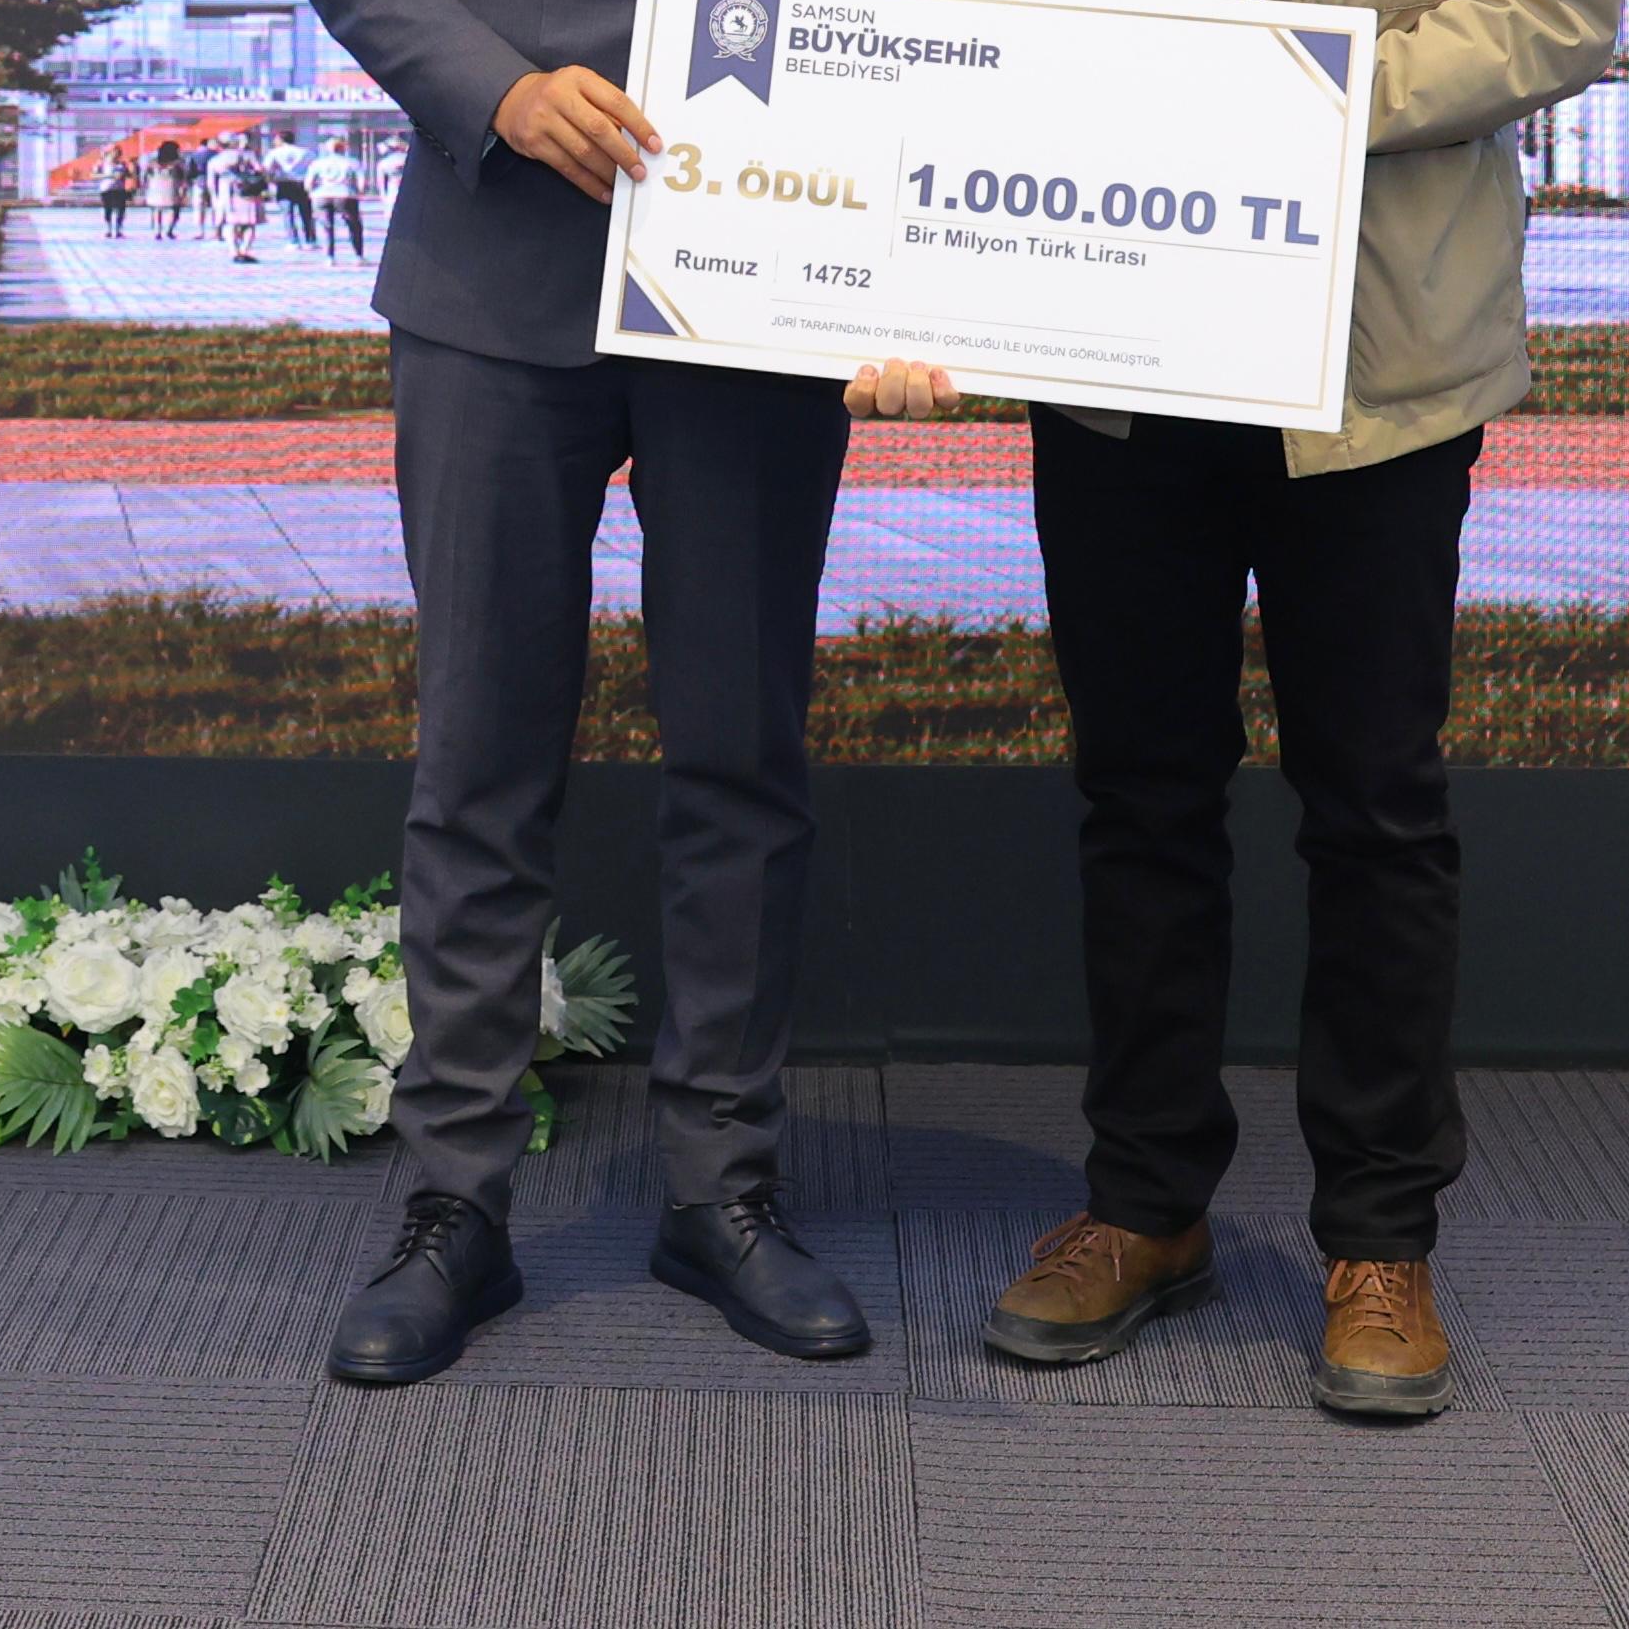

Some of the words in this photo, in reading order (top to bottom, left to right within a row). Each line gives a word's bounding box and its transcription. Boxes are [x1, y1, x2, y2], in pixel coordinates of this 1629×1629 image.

[791, 3, 876, 25] SAMSUN
[788, 24, 1001, 69] BÜYÜKŞEHİR
[785, 58, 901, 82] BELEDİYESİ
[663, 143, 722, 195] 3.
[737, 159, 868, 210] ÖDÜL
[909, 164, 1216, 235] 1.000.000
[1241, 195, 1320, 246] TL
[905, 225, 938, 244] Bir
[944, 229, 1018, 253] Milyon
[1026, 237, 1077, 260] Türk
[1084, 243, 1147, 267] Lirası
[675, 249, 758, 276] Rumuz
[802, 262, 872, 288] 14752
[771, 315, 797, 328] JÜRİ
[800, 318, 871, 336] TARAFINDAN
[874, 327, 891, 338] OY
[893, 328, 934, 343] BİRLİĞİ
[943, 333, 1001, 350] ÇOKLUĞU
[1003, 339, 1021, 352] İLE
[1023, 344, 1067, 357] UYGUN
[1069, 347, 1163, 368] GÖRÜLMÜŞTÜR.
